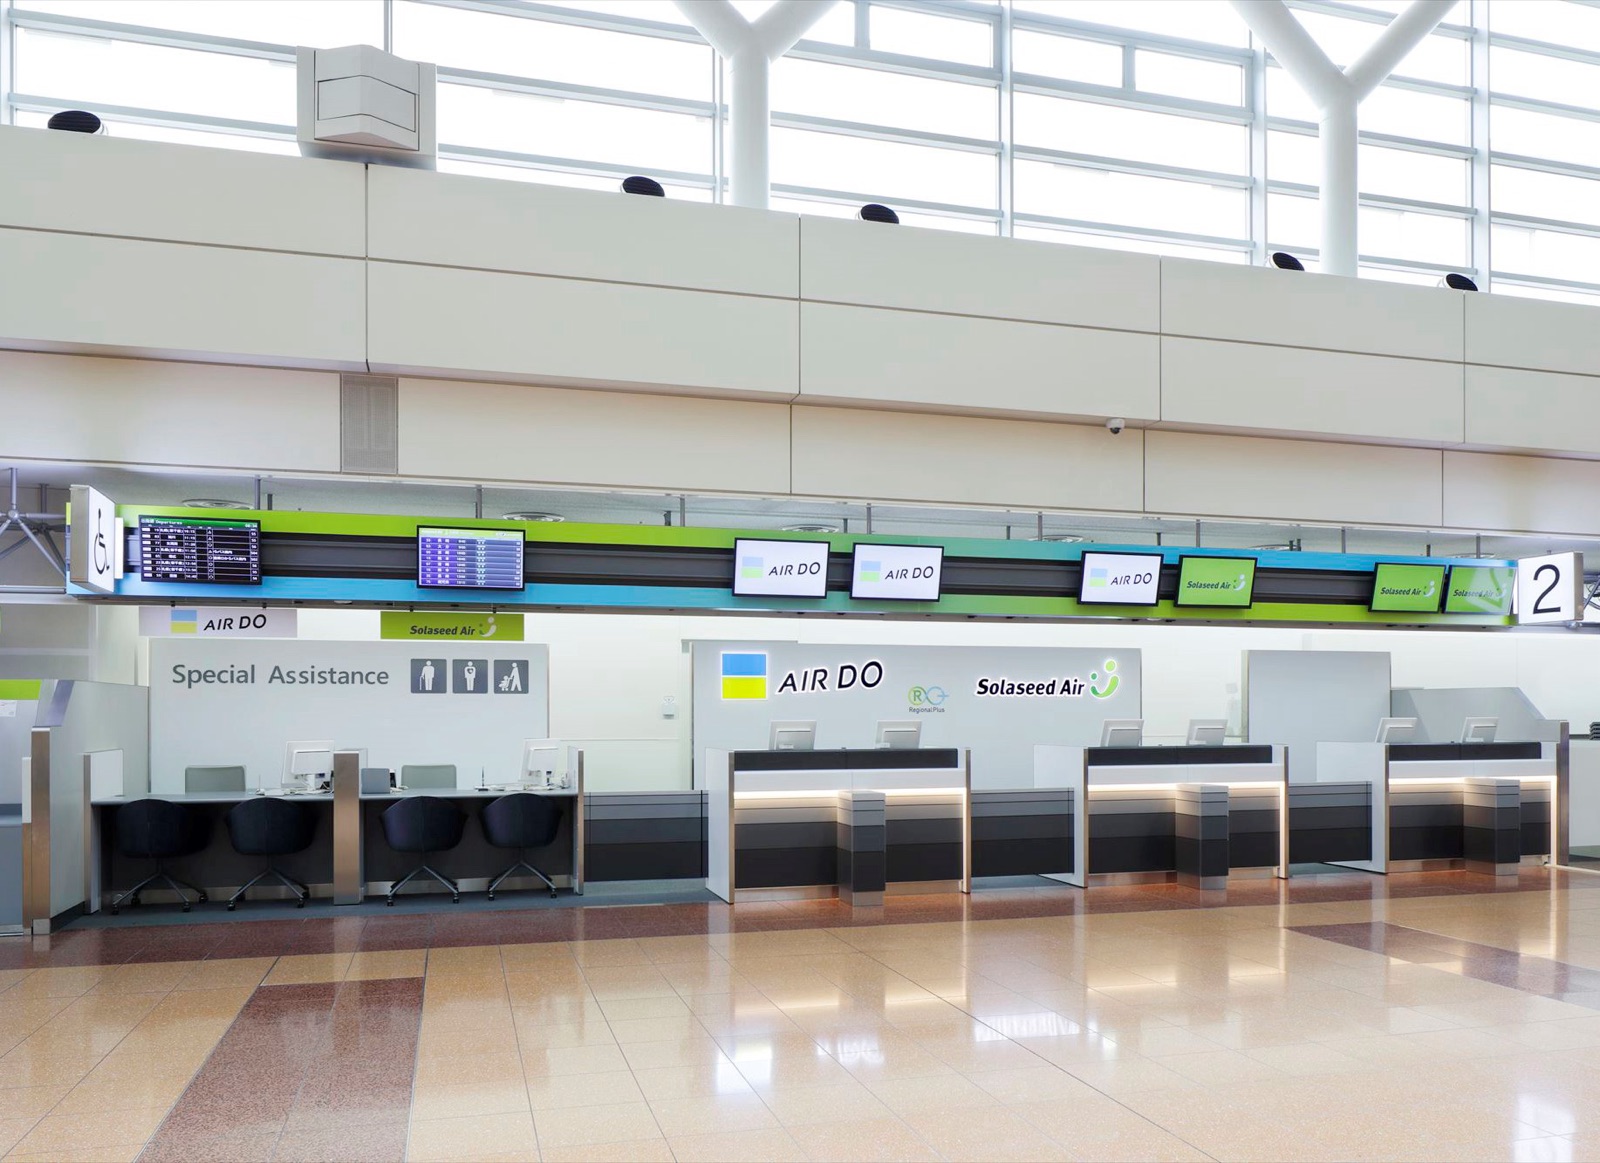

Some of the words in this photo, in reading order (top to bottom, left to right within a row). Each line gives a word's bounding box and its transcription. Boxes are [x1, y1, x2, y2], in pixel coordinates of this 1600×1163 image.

[768, 565, 794, 576] AIR
[797, 562, 821, 576] DO
[884, 568, 909, 580] AIR
[911, 566, 934, 580] DO
[1110, 575, 1131, 586] AIR
[1133, 573, 1153, 585] DO
[1186, 580, 1219, 589] Solaseed
[1219, 582, 1231, 590] Air
[1380, 587, 1411, 596] Solaseed
[1411, 588, 1422, 596] Air
[1533, 564, 1561, 614] 2
[203, 618, 234, 631] AIR
[238, 613, 267, 630] DO
[409, 625, 458, 636] Solaseed
[459, 626, 476, 636] Air
[172, 664, 255, 689] Special
[268, 665, 389, 685] Assistance
[778, 668, 828, 693] AIR
[837, 661, 883, 689] DO
[976, 678, 1056, 696] Solaseed
[1059, 679, 1086, 695] Air
